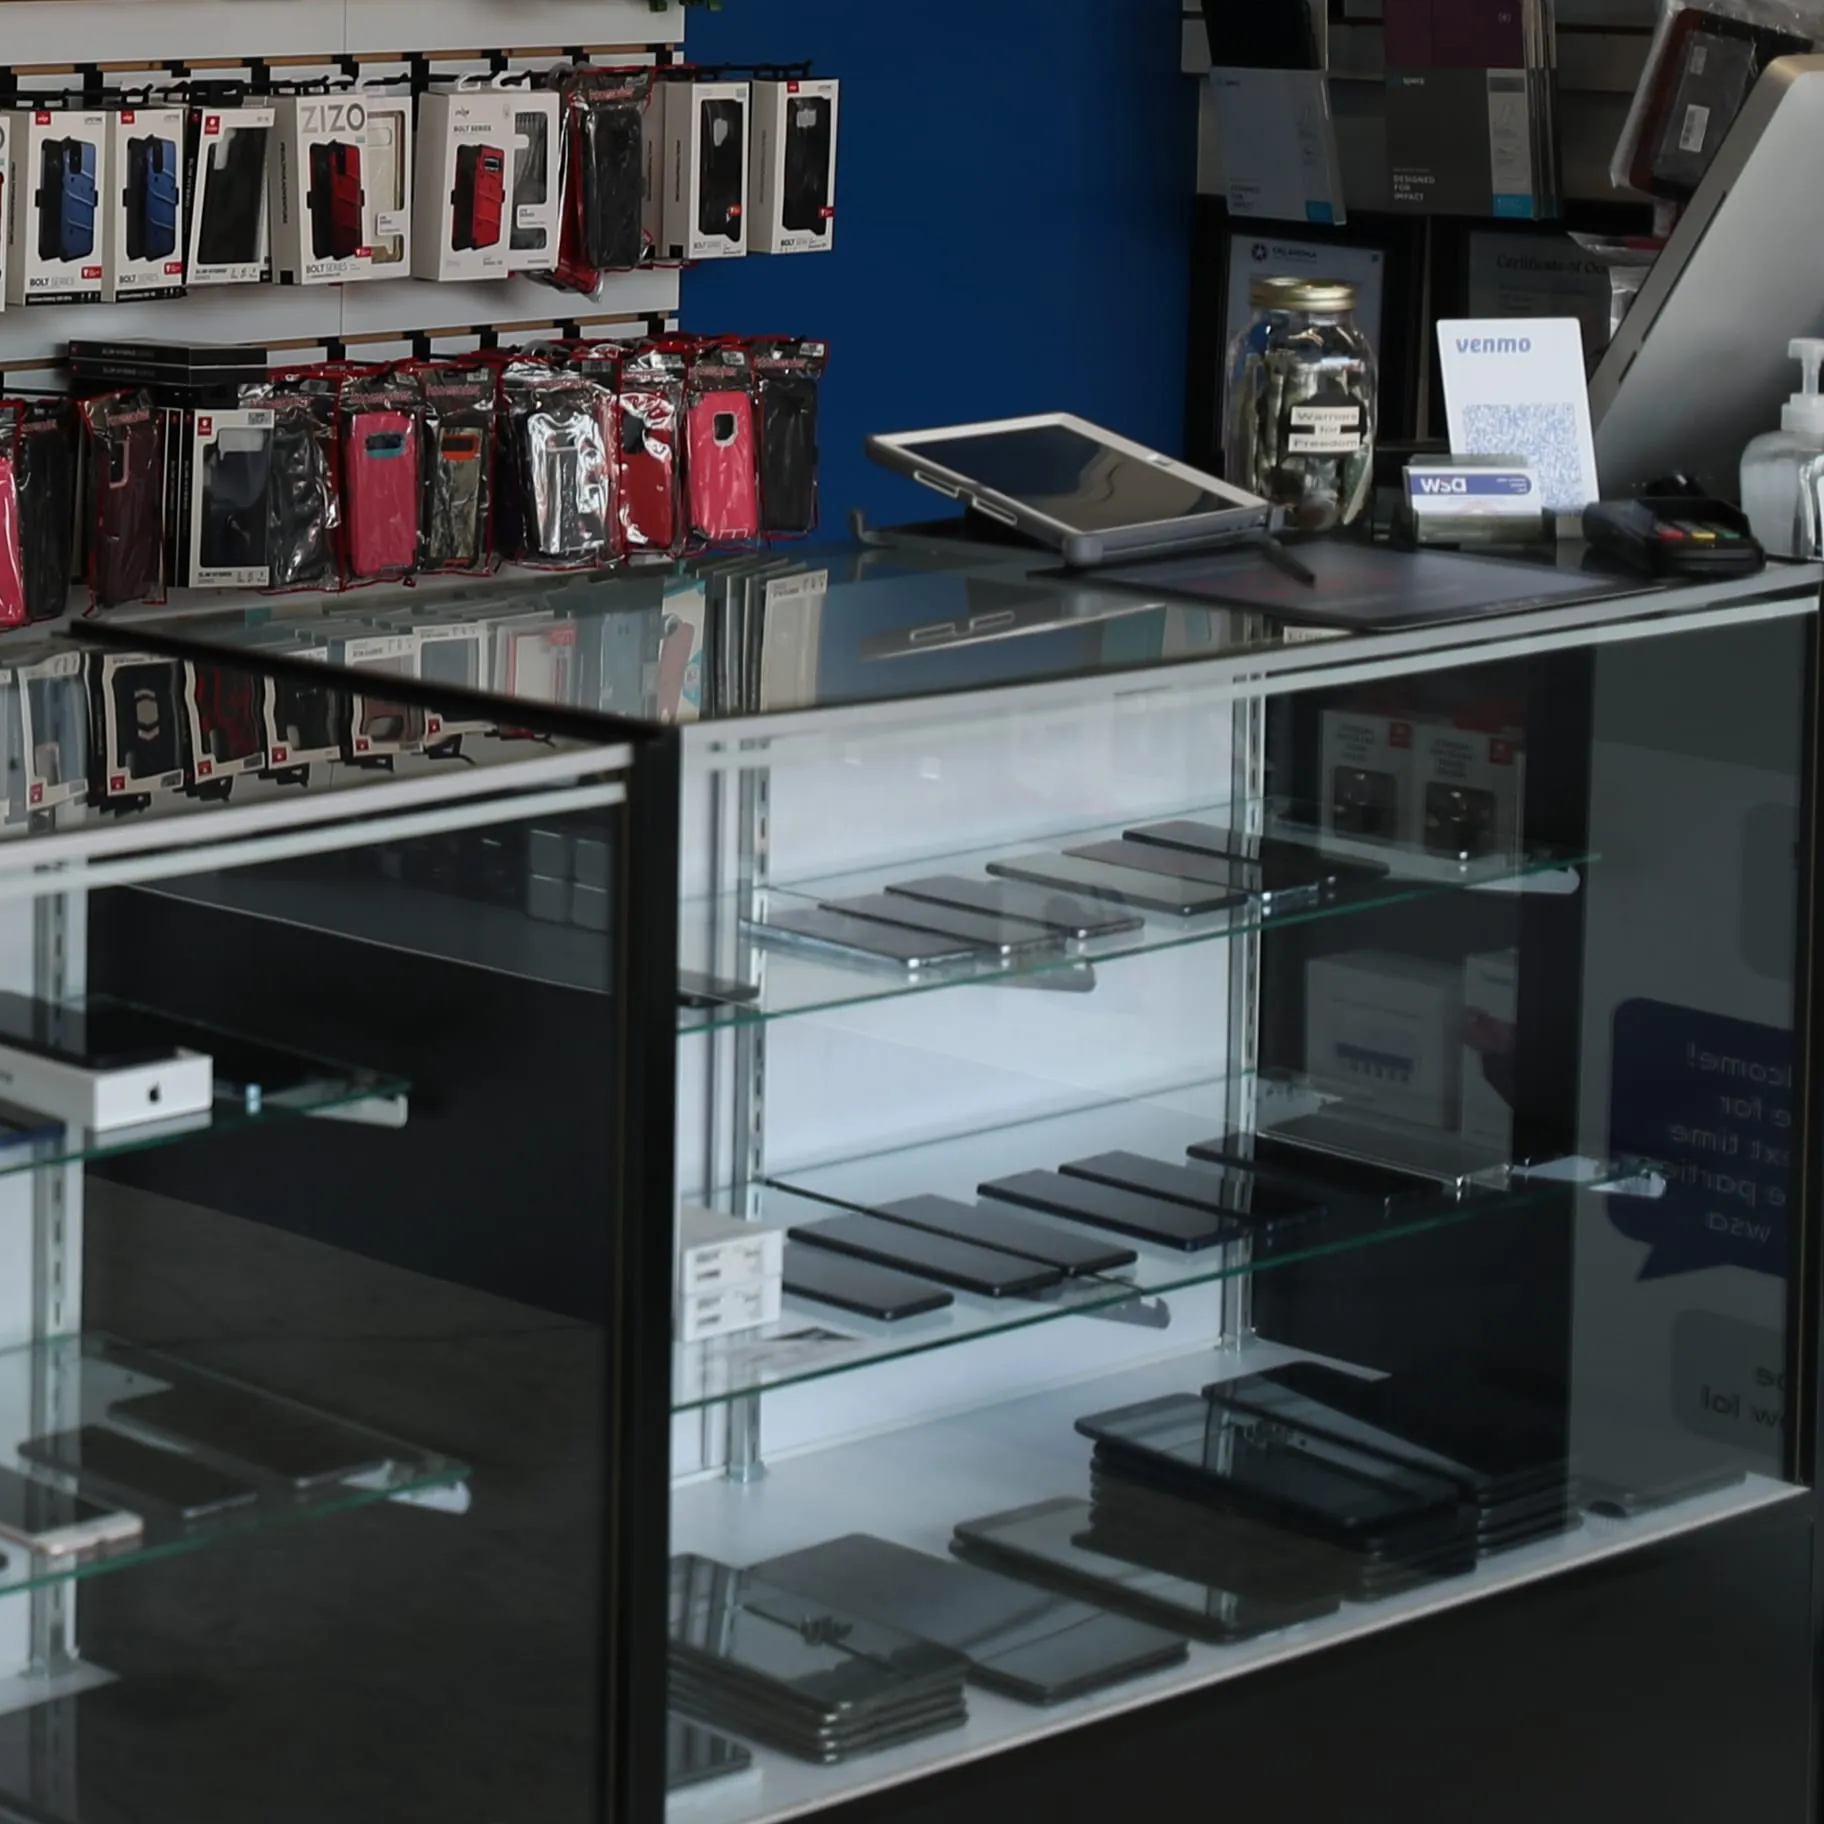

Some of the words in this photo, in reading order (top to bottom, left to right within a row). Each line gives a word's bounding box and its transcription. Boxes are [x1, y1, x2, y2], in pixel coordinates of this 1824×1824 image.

[301, 103, 365, 133] ZIZO
[1393, 175, 1435, 184] DESIGNED
[1393, 184, 1411, 192] FOR
[1393, 192, 1425, 202] IMPACT
[305, 264, 325, 274] BOLT
[29, 277, 49, 286] BOLT
[1455, 336, 1531, 353] venmo
